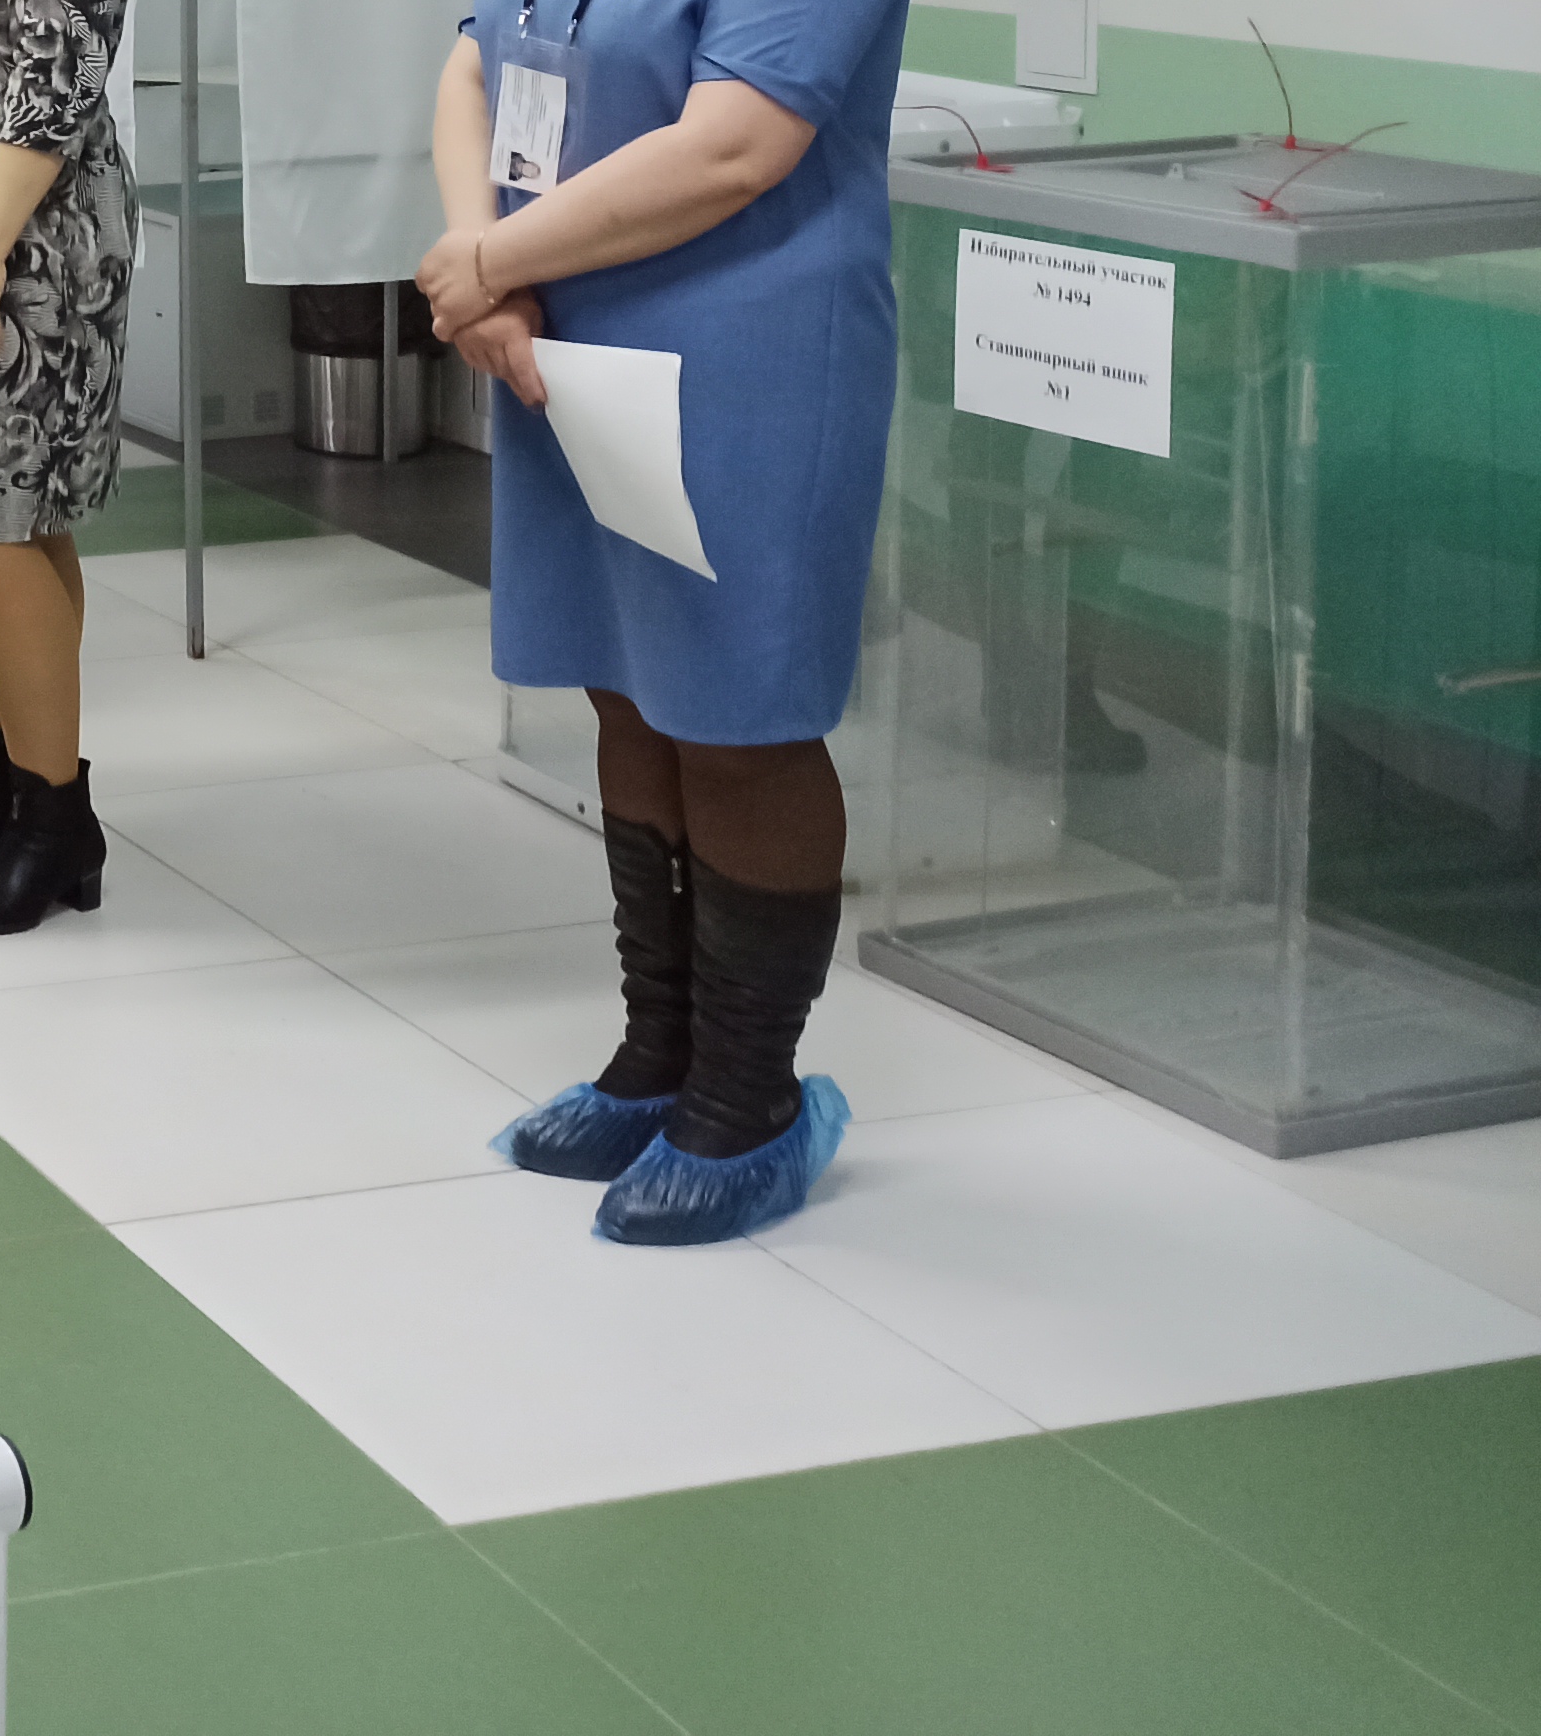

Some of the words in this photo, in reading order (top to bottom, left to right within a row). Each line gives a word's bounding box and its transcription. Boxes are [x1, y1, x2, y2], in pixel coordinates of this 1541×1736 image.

[970, 237, 1096, 276] Избирательный
[1101, 265, 1168, 290] участок
[1033, 281, 1052, 300] №
[1057, 285, 1092, 307] 1494
[975, 333, 1096, 375] Стационарный
[1101, 364, 1149, 387] ящик
[1044, 380, 1071, 402] №1
